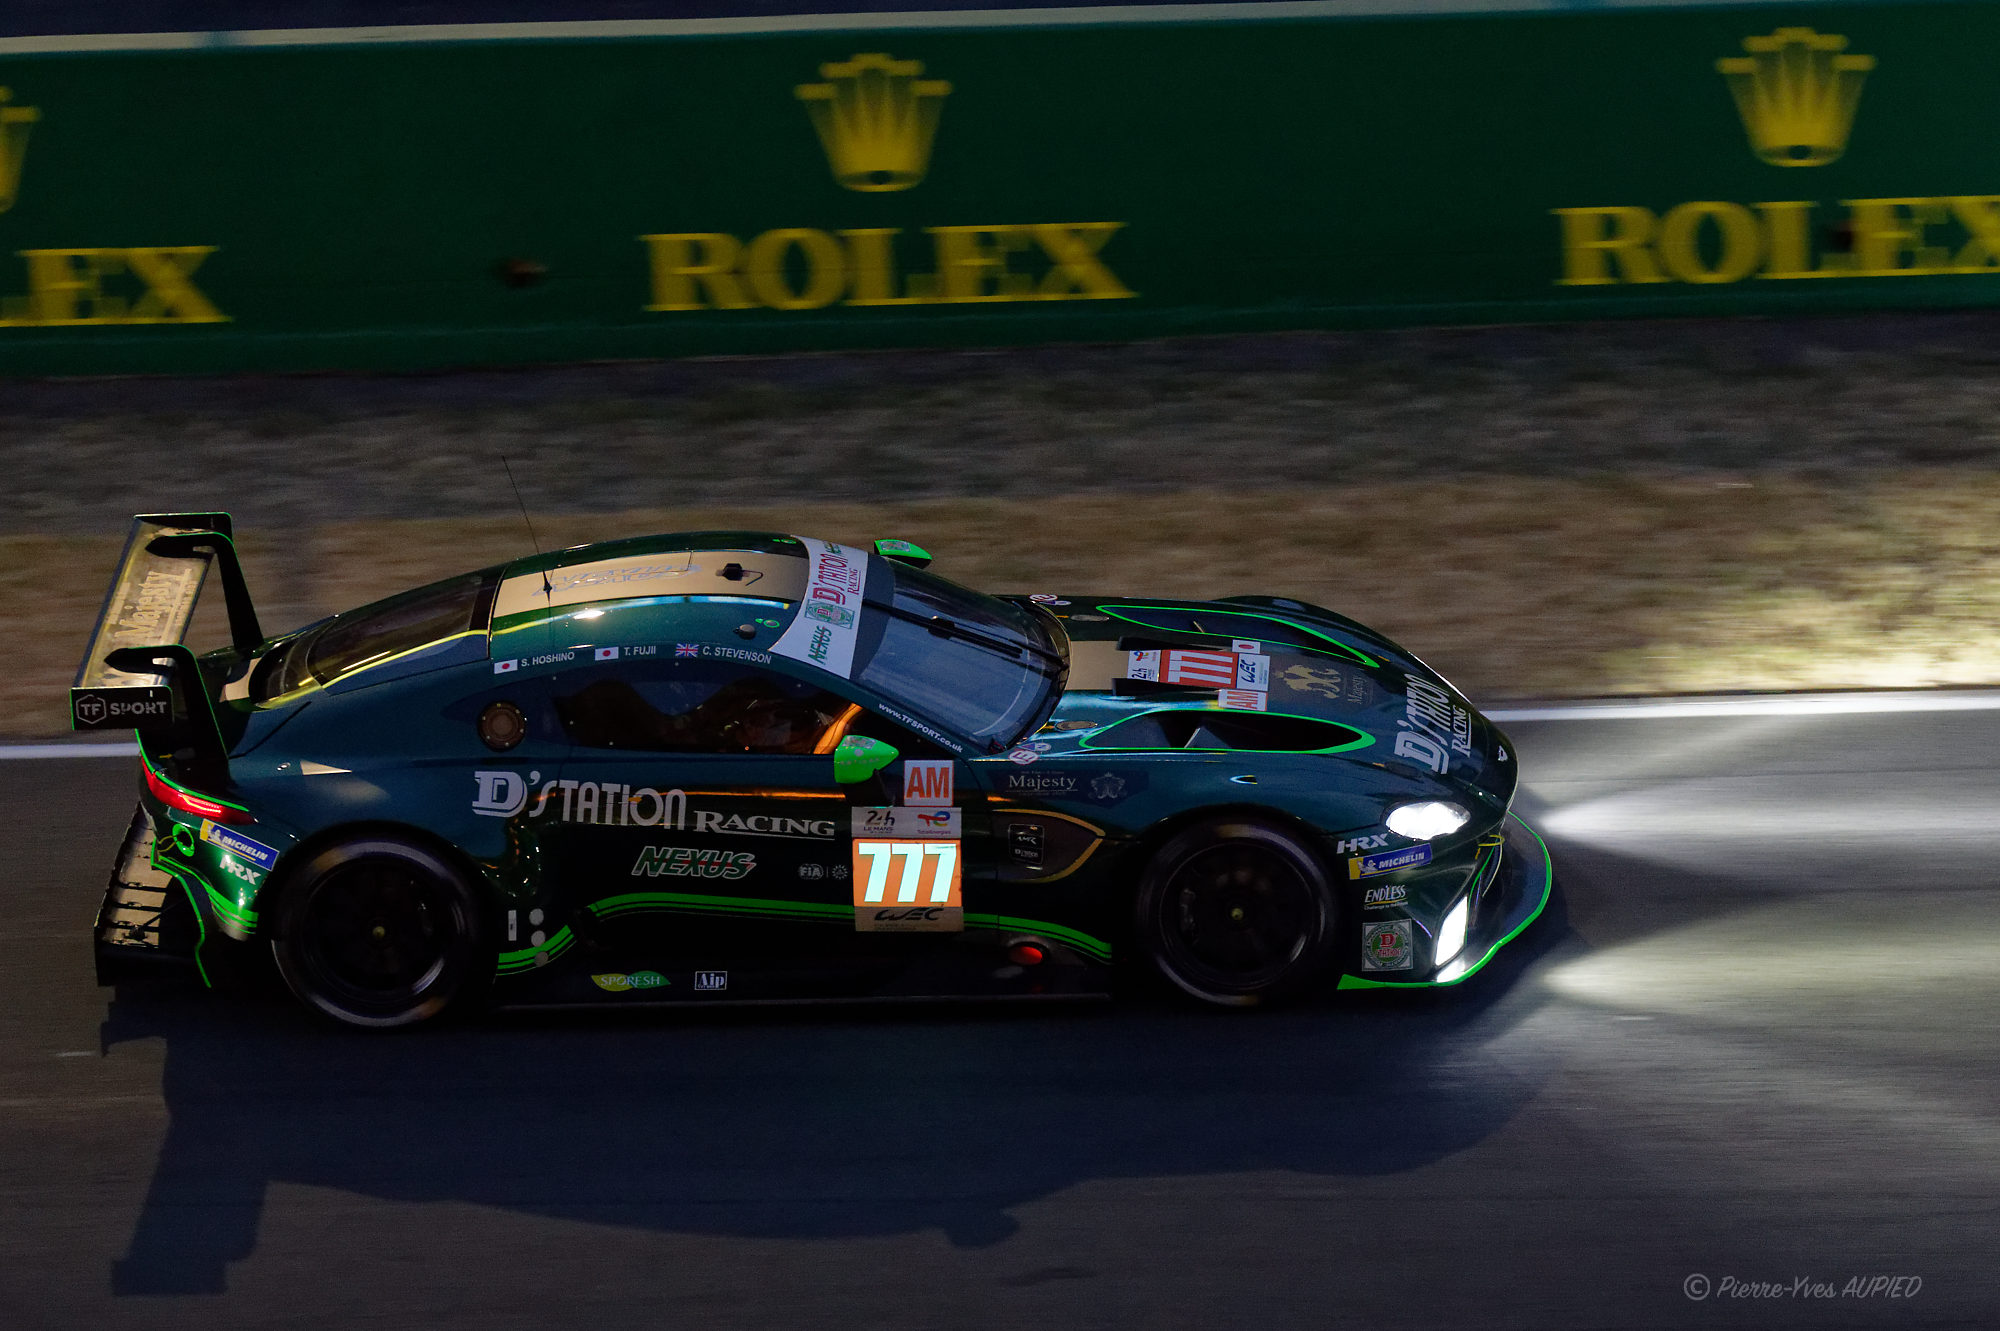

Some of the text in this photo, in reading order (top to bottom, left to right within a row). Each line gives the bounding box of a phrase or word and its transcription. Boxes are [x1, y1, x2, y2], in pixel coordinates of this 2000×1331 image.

[638, 221, 1140, 311] ROLEX
[847, 568, 861, 595] RACING
[114, 571, 184, 638] Majesty
[623, 646, 657, 657] T. FUJII
[702, 646, 772, 665] C. STEVENSON
[808, 625, 832, 664] NEXUS
[521, 652, 575, 668] S. HOSHINO
[1168, 650, 1233, 684] 777
[1240, 659, 1256, 684] WEC
[80, 701, 167, 716] TF SPORT
[1226, 691, 1258, 709] AM
[878, 702, 963, 754] www.TFSPORT.co.uk
[1451, 704, 1472, 758] RACING
[906, 766, 949, 799] AM
[1008, 775, 1076, 790] Majesty
[472, 770, 835, 838] D'STATION RACING
[221, 836, 269, 861] MICHELIN
[1336, 833, 1389, 854] HRX
[219, 854, 261, 886] HRX
[631, 845, 757, 879] NEXUS
[859, 843, 957, 902] 777
[1378, 851, 1425, 869] MICHELIN
[1364, 884, 1407, 903] ENDLESS
[875, 907, 944, 921] WEC
[600, 976, 660, 988] SPORESH
[698, 973, 725, 988] Aip
